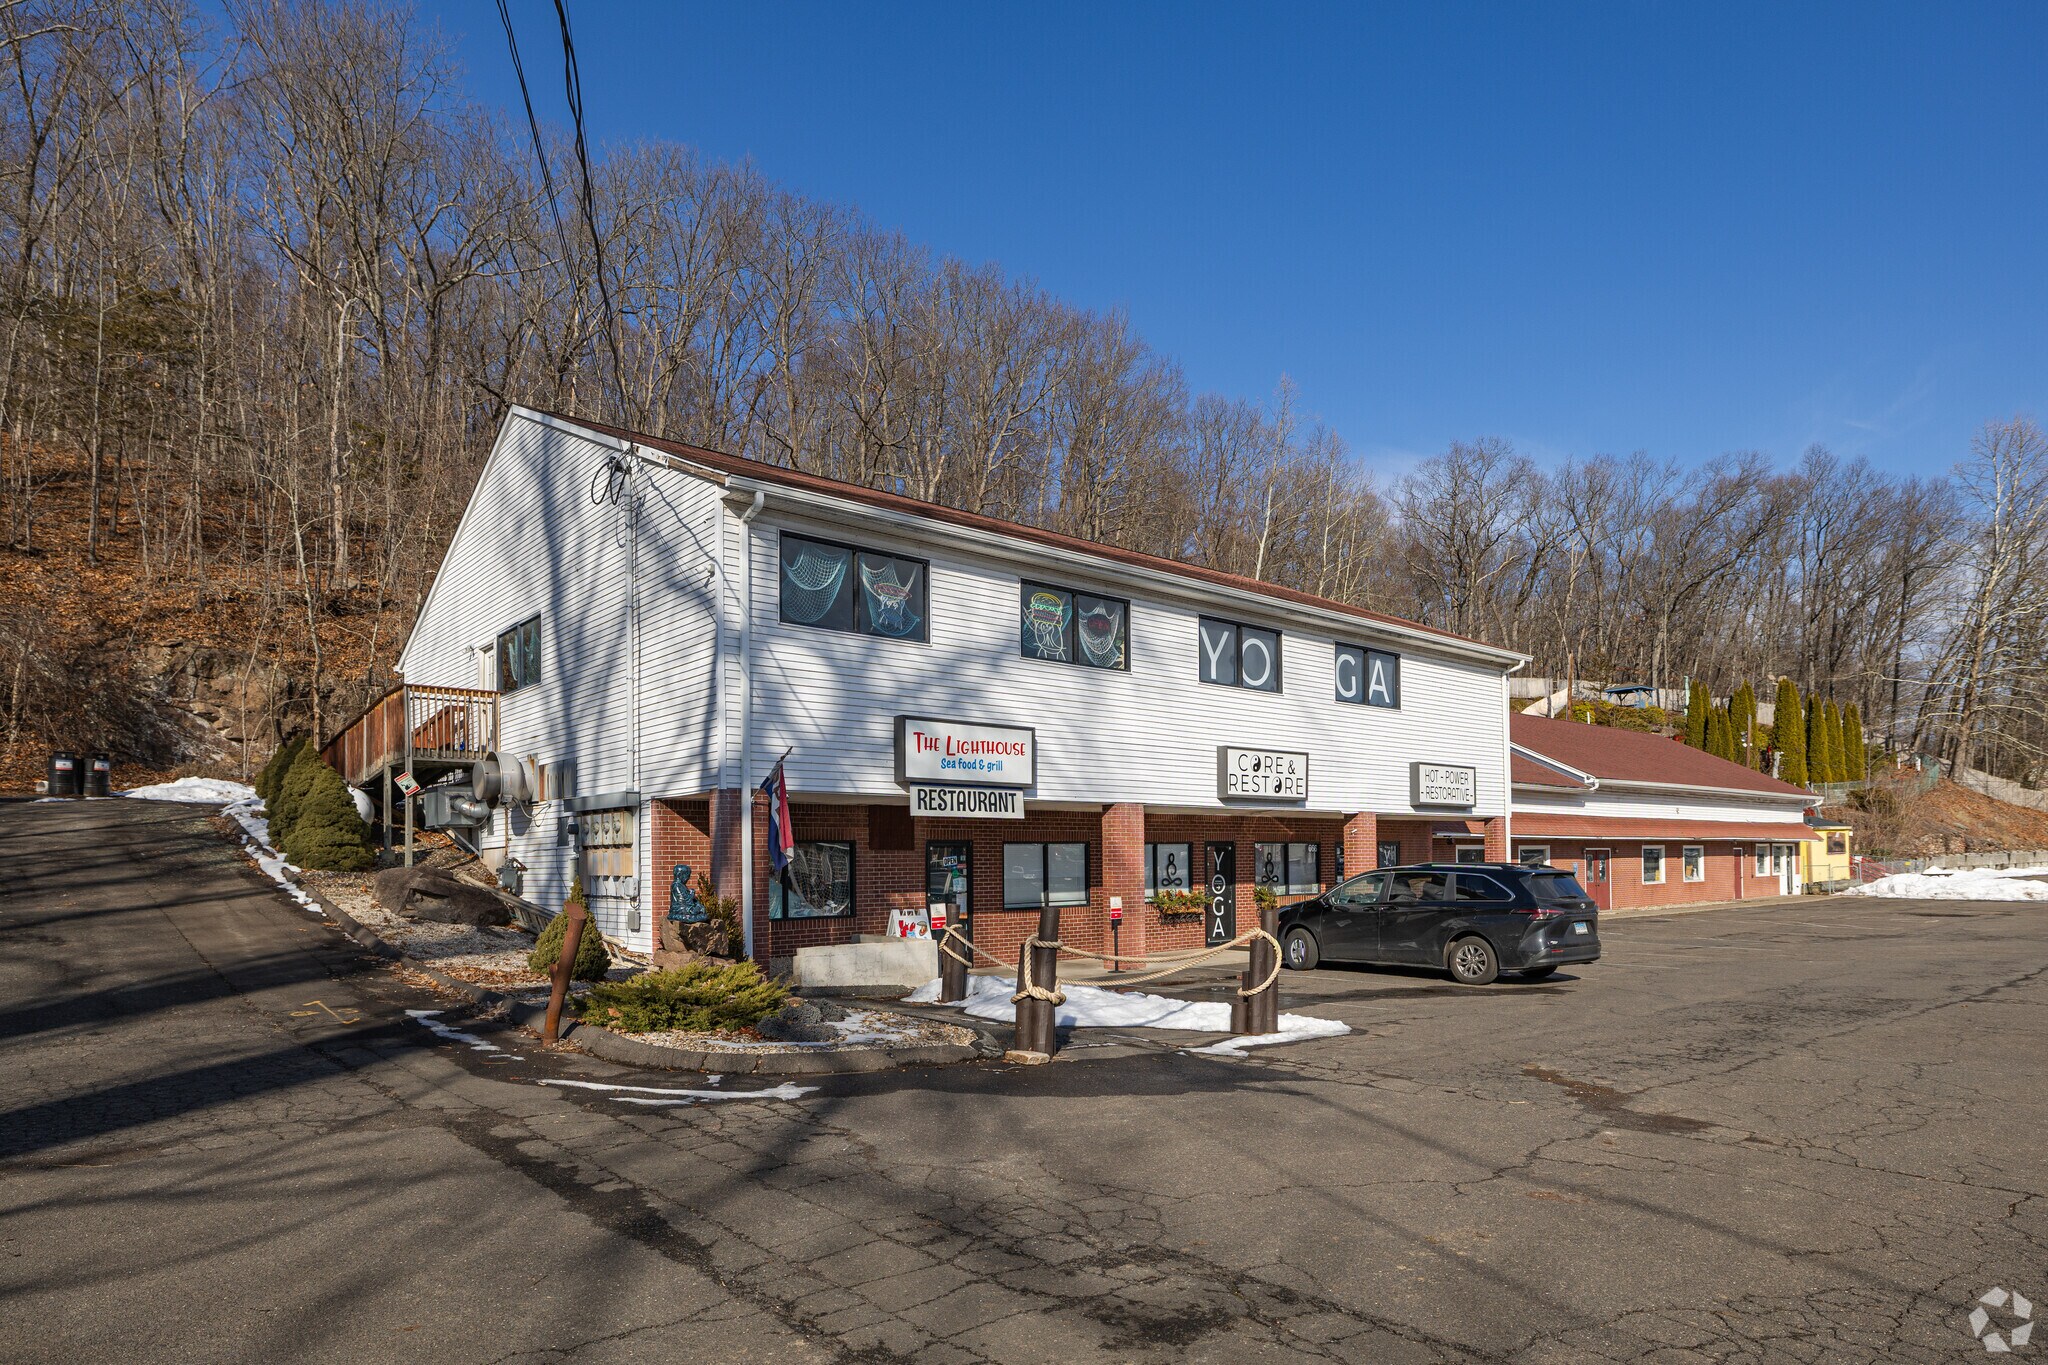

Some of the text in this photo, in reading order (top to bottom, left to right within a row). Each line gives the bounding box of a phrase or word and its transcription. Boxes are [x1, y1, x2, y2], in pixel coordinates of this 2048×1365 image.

[912, 731, 1026, 756] THE LIGHTHOUSE
[940, 758, 1003, 773] Sea food & grill
[1238, 753, 1296, 775] CORE &
[1229, 773, 1304, 795] RESTORE
[1424, 769, 1439, 783] HOT
[1445, 770, 1469, 785] POWER
[917, 788, 1017, 813] RESTAURANT
[943, 857, 957, 866] OPEN
[1211, 851, 1226, 938] YOGA
